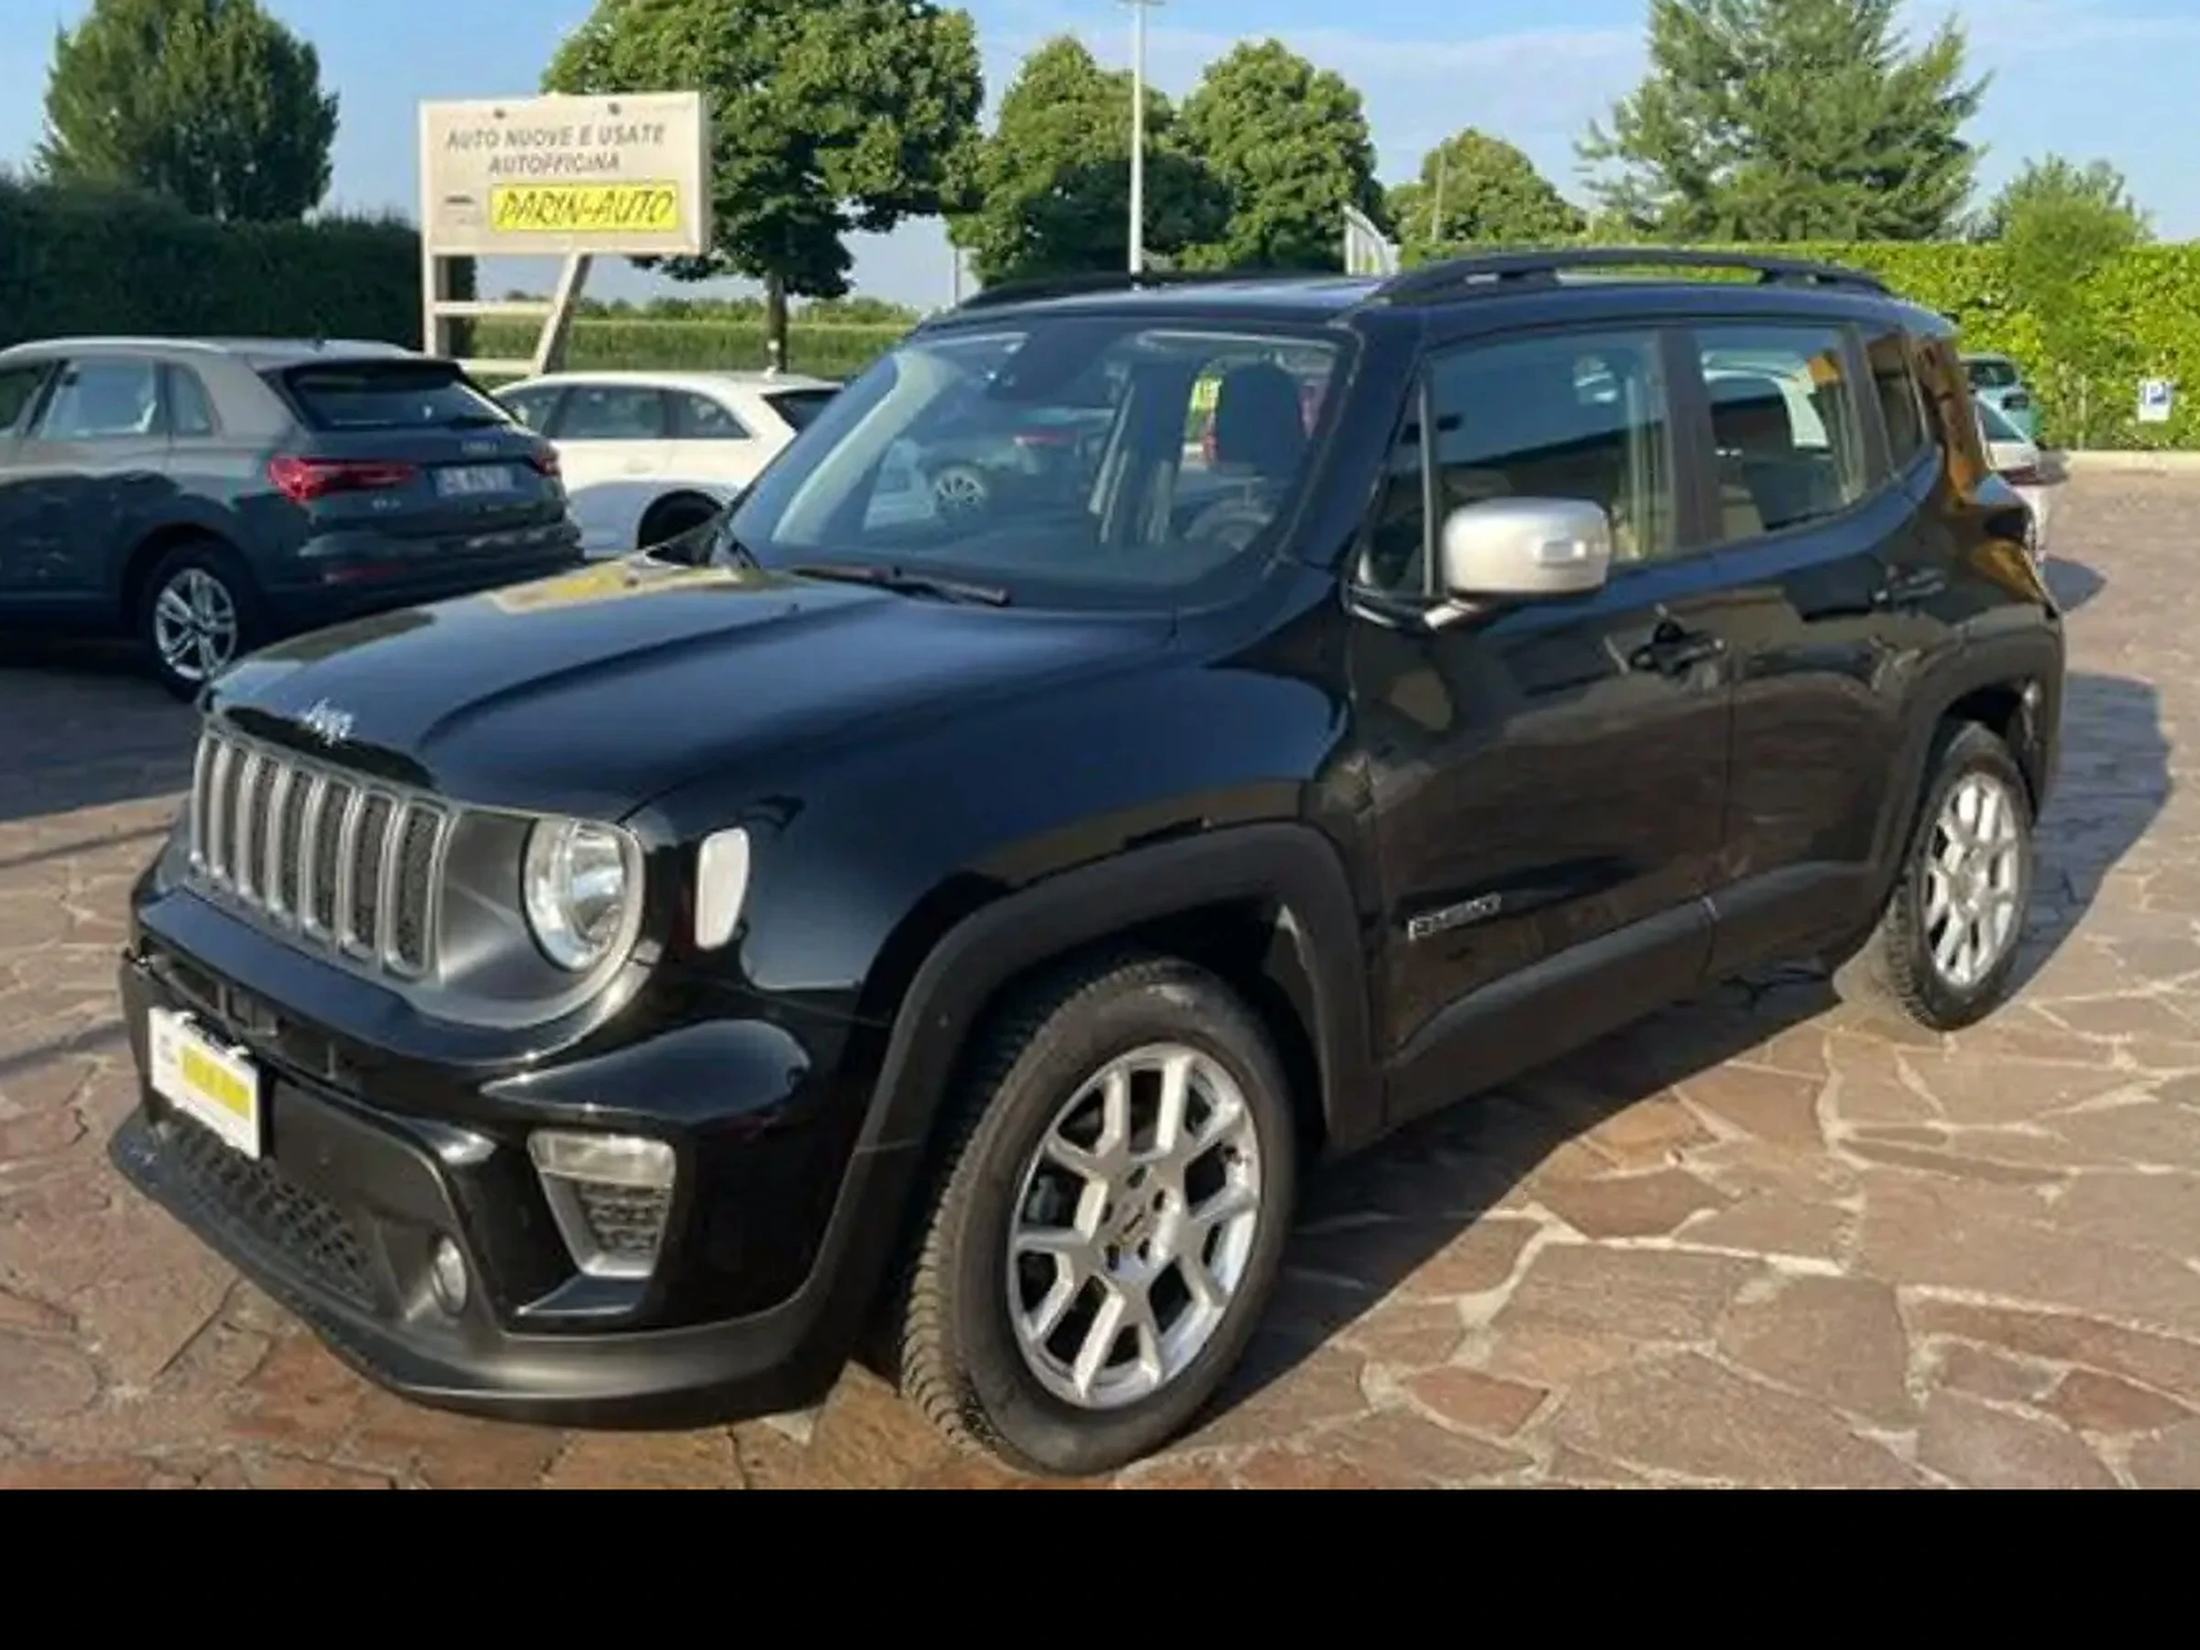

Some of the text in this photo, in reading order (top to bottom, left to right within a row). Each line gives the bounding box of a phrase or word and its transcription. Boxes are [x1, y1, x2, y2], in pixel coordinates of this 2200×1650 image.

[447, 124, 665, 148] AUTO NUOVE E USATE
[488, 151, 620, 174] AUTOFFICINA
